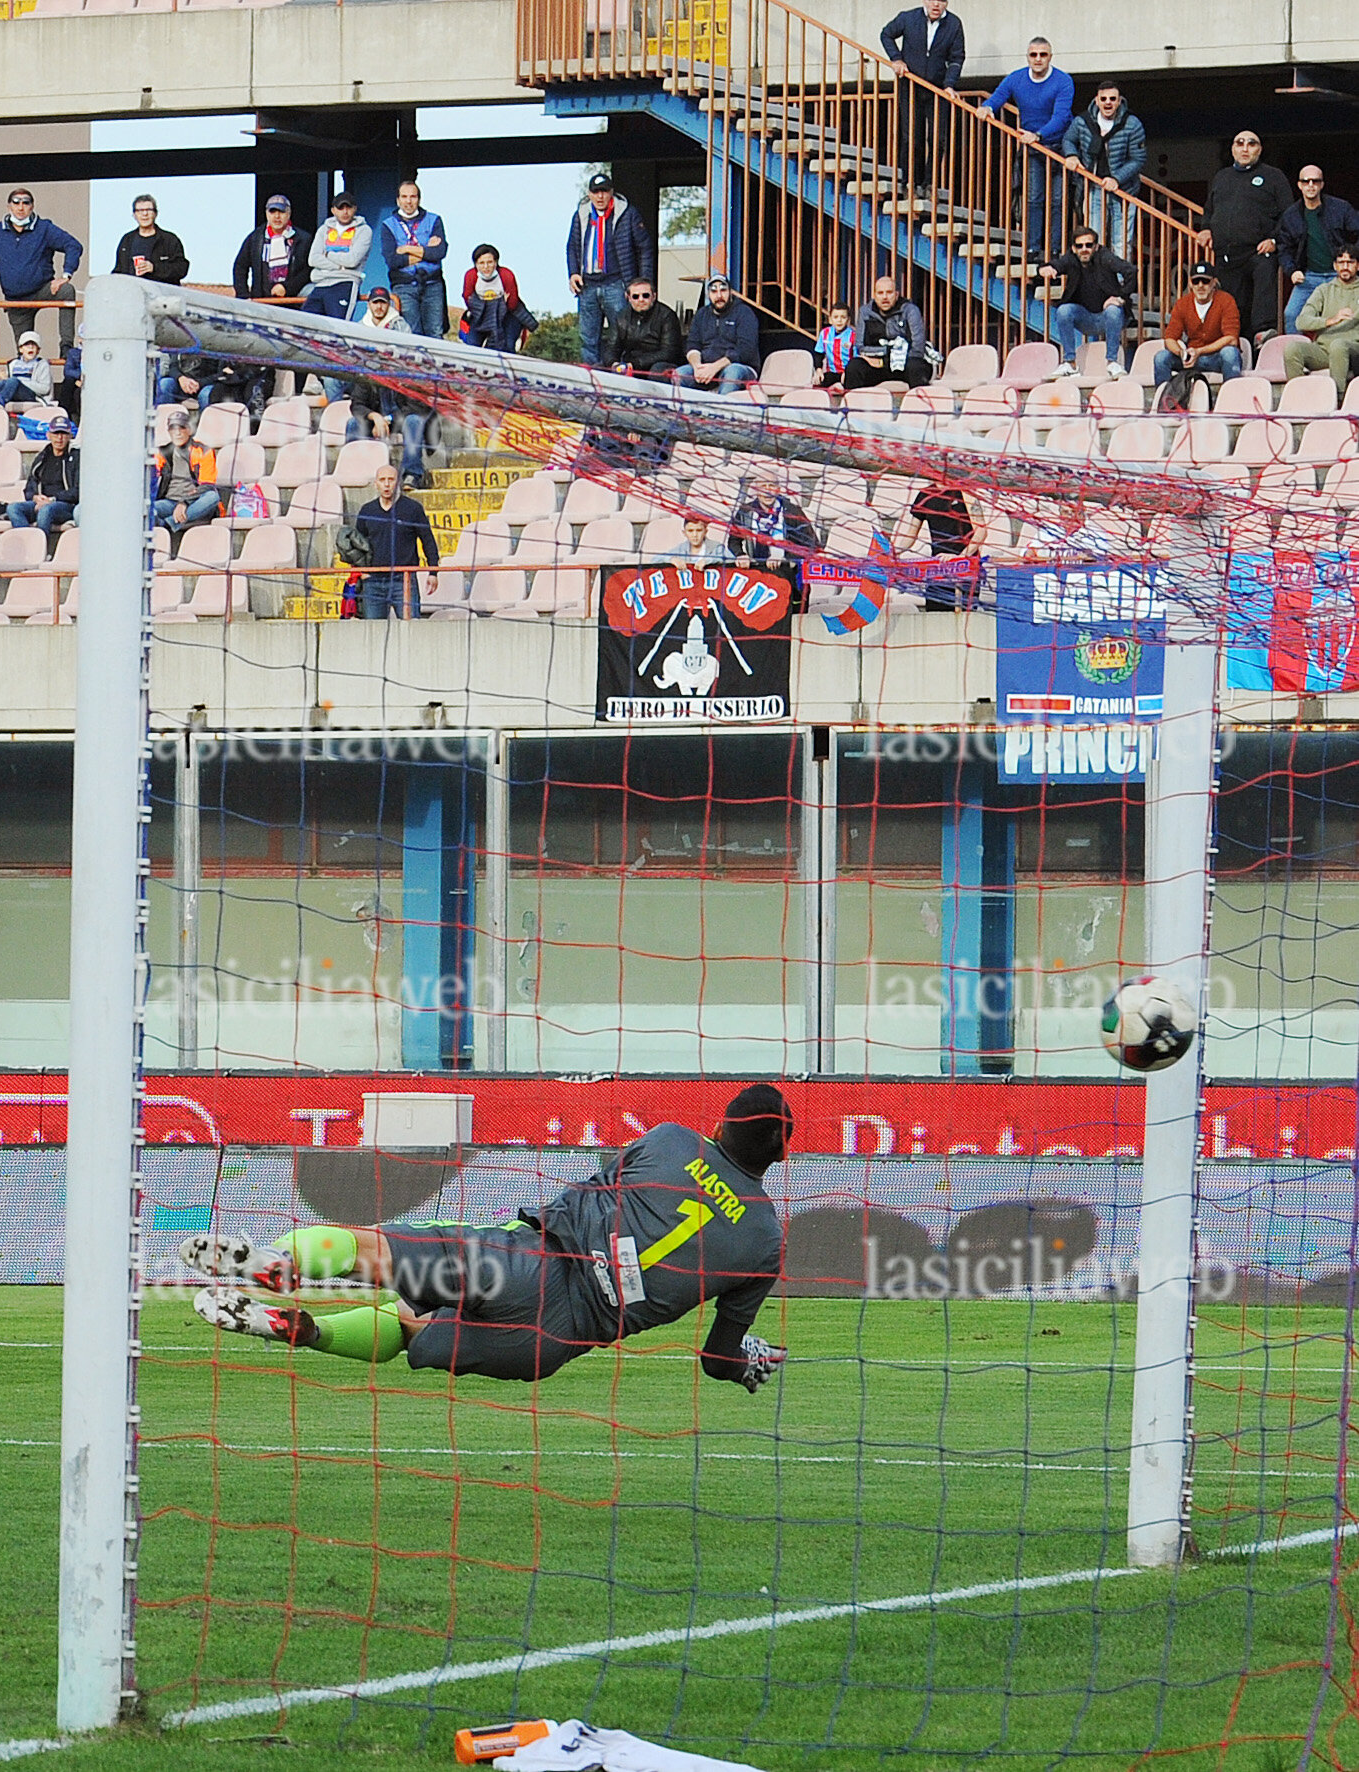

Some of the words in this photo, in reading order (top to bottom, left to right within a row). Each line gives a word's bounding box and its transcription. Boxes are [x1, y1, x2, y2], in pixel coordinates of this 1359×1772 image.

[464, 471, 500, 488] FILA
[622, 568, 779, 620] TERRUN
[609, 700, 665, 719] FIERO
[673, 700, 691, 719] DI
[703, 697, 781, 719] ESSERLO
[1075, 696, 1135, 715] CATANIA
[683, 1157, 747, 1225] ALASTRA
[638, 1198, 716, 1272] 1
